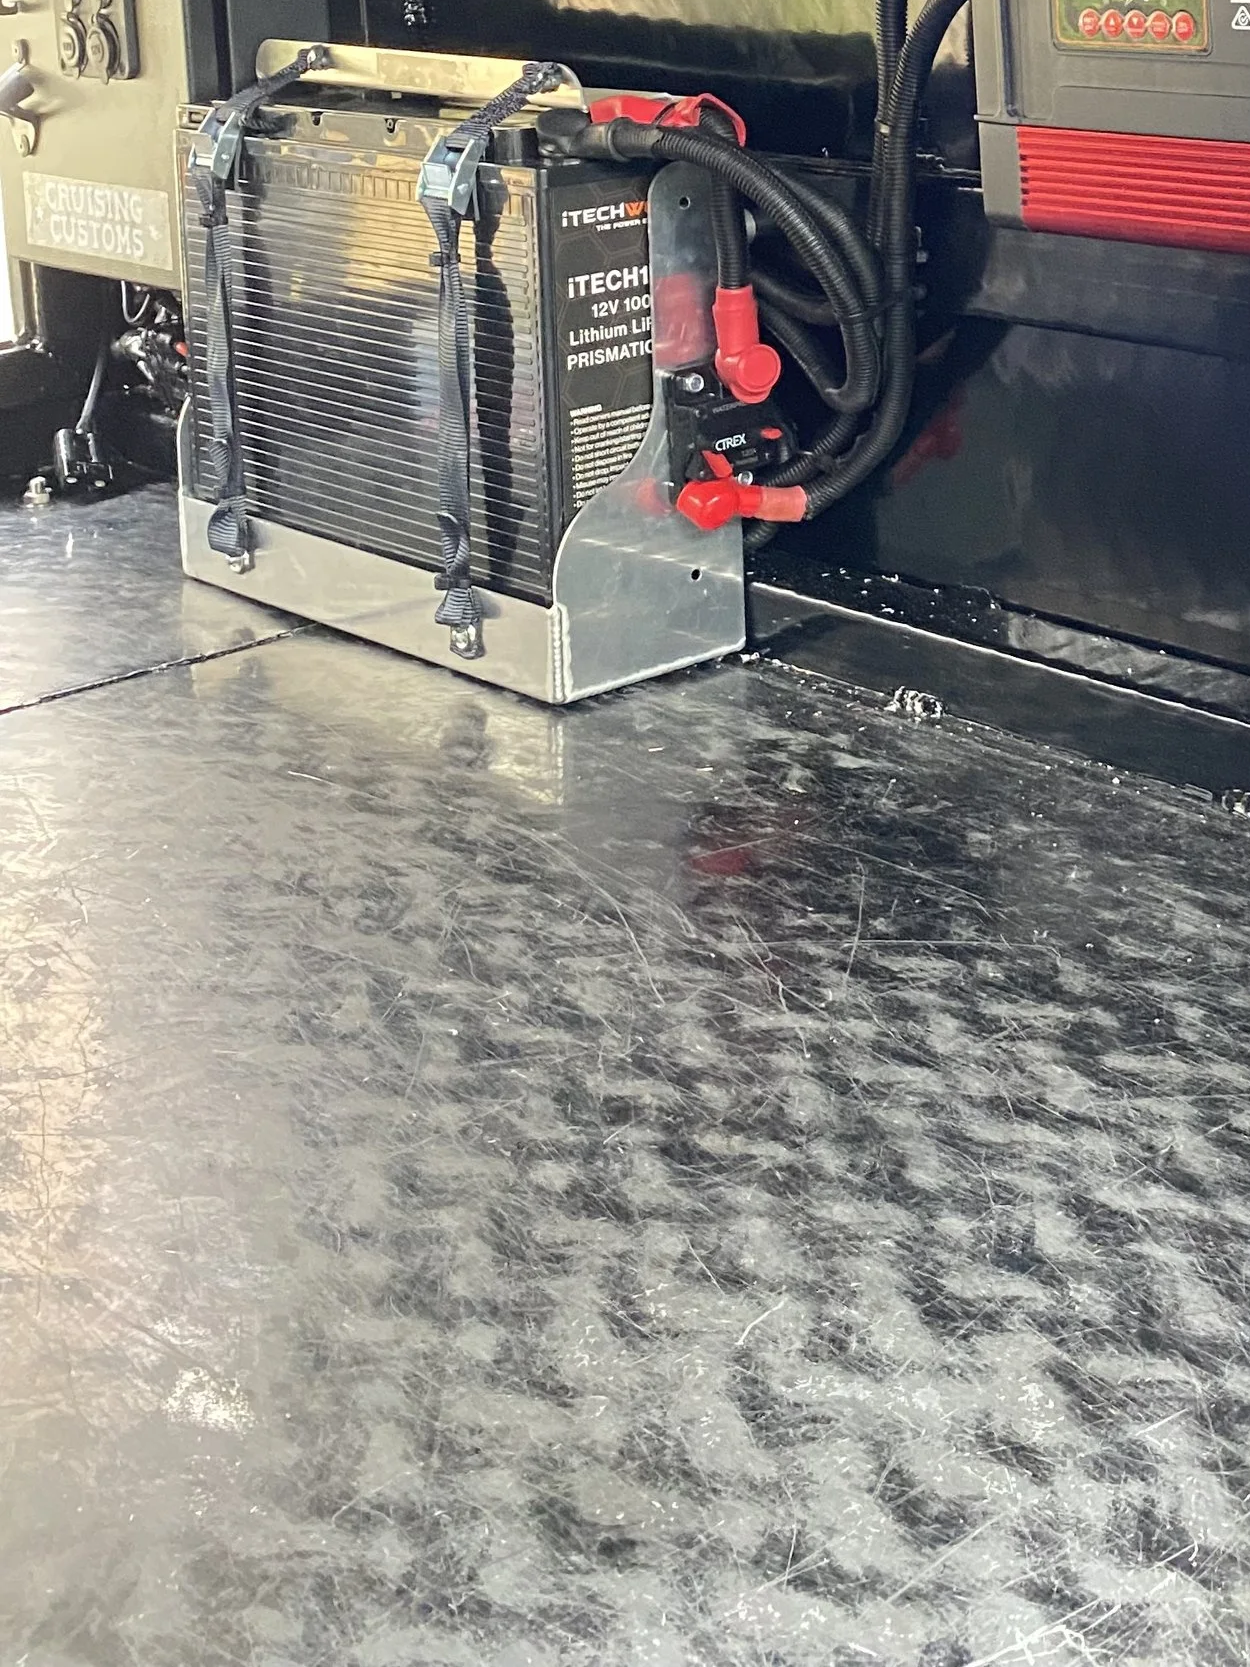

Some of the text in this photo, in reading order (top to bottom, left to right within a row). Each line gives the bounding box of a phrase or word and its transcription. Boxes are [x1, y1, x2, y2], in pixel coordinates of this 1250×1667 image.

[45, 182, 144, 224] CRUISING
[561, 200, 651, 227] iTECHW
[596, 219, 641, 232] THE POWER
[50, 214, 145, 259] CUSTOMS
[591, 298, 620, 318] 12V
[569, 324, 628, 346] Lithium
[610, 407, 631, 417] manual
[573, 423, 597, 436] Operate
[597, 421, 605, 431] by
[609, 413, 640, 428] competent
[589, 432, 599, 441] out
[574, 444, 585, 454] Not
